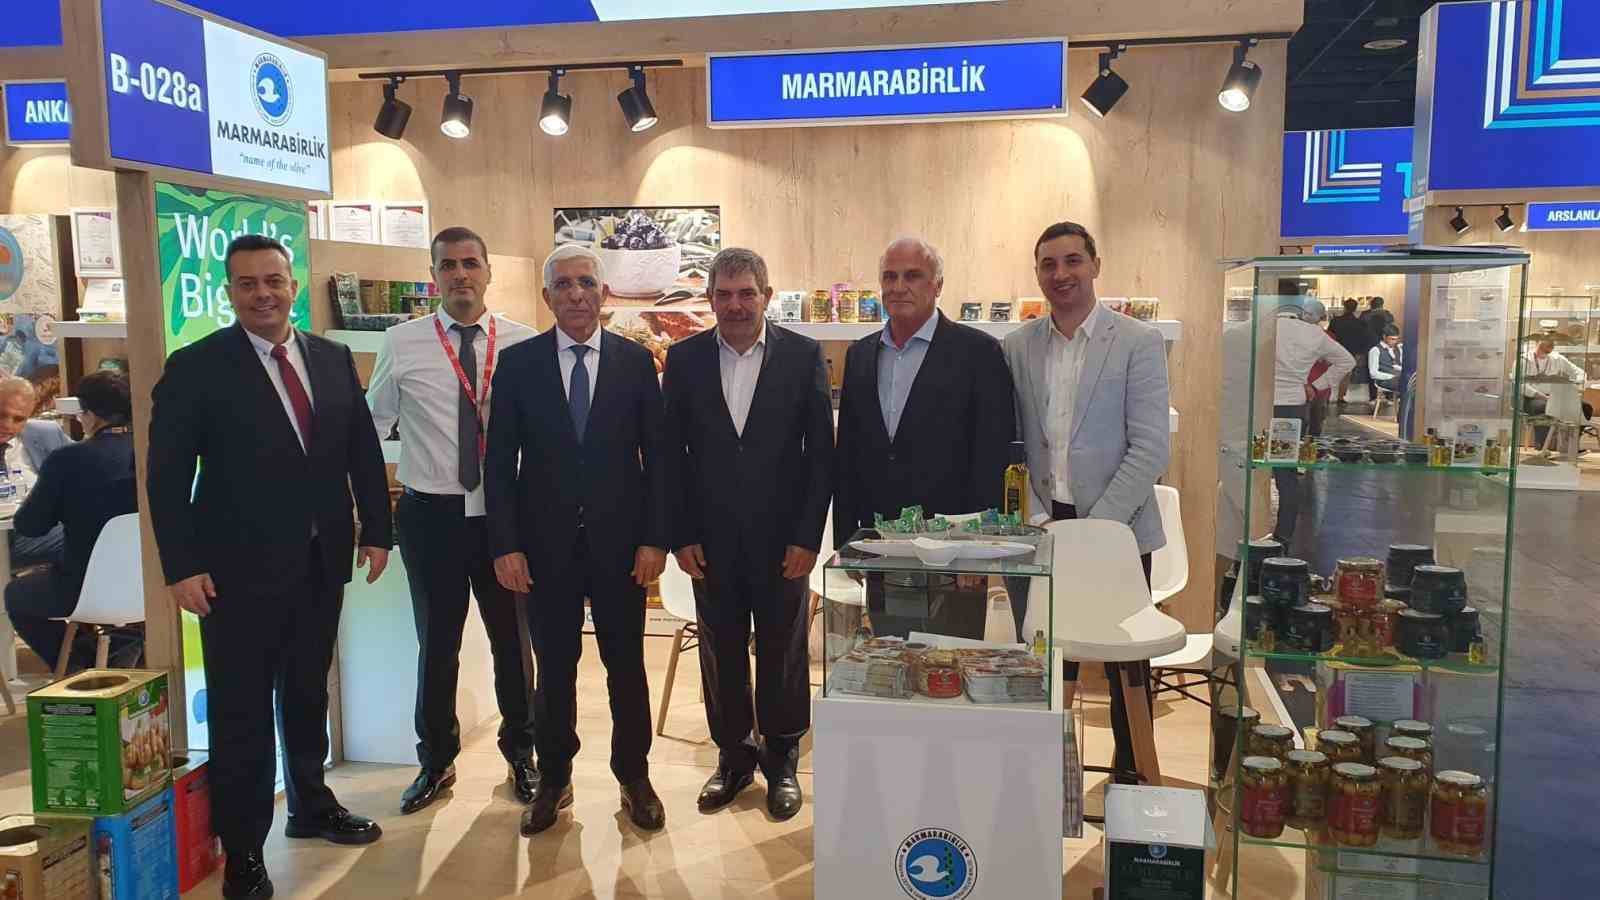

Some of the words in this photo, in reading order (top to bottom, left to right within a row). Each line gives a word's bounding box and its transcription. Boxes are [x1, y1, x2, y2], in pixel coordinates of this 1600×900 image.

[111, 53, 202, 112] B-028a
[783, 60, 986, 99] MARMARABİRLİK
[217, 119, 325, 159] MARMARABİRLİK
